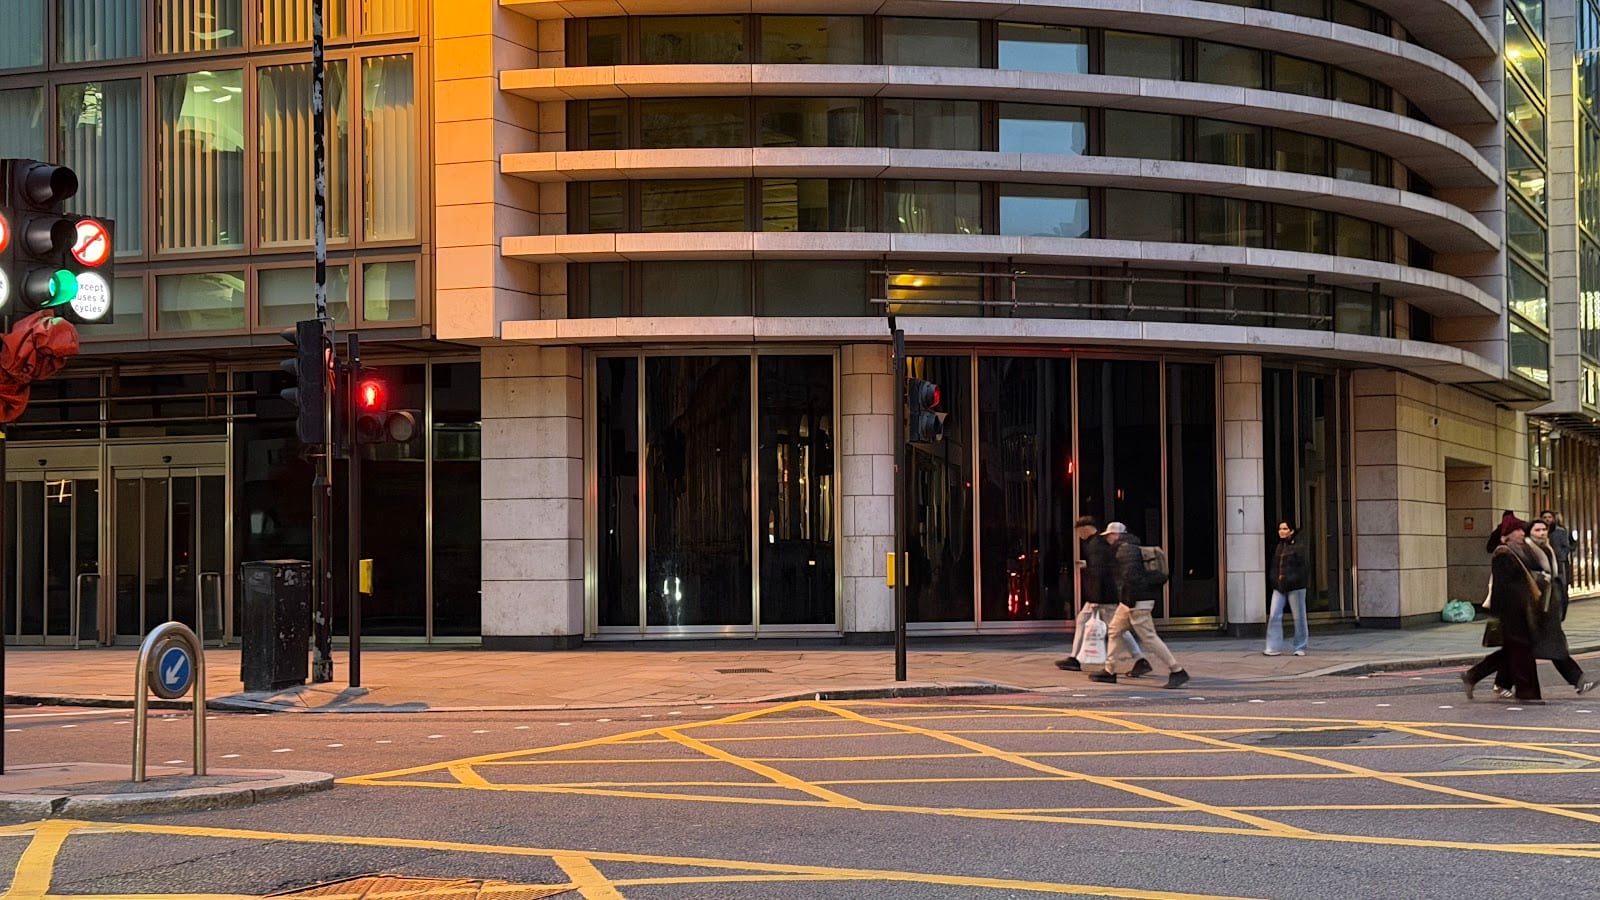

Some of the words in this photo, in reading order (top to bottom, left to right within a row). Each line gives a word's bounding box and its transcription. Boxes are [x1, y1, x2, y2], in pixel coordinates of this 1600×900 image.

[79, 283, 104, 293] xcept
[77, 294, 97, 302] uses
[74, 303, 102, 313] cycles
